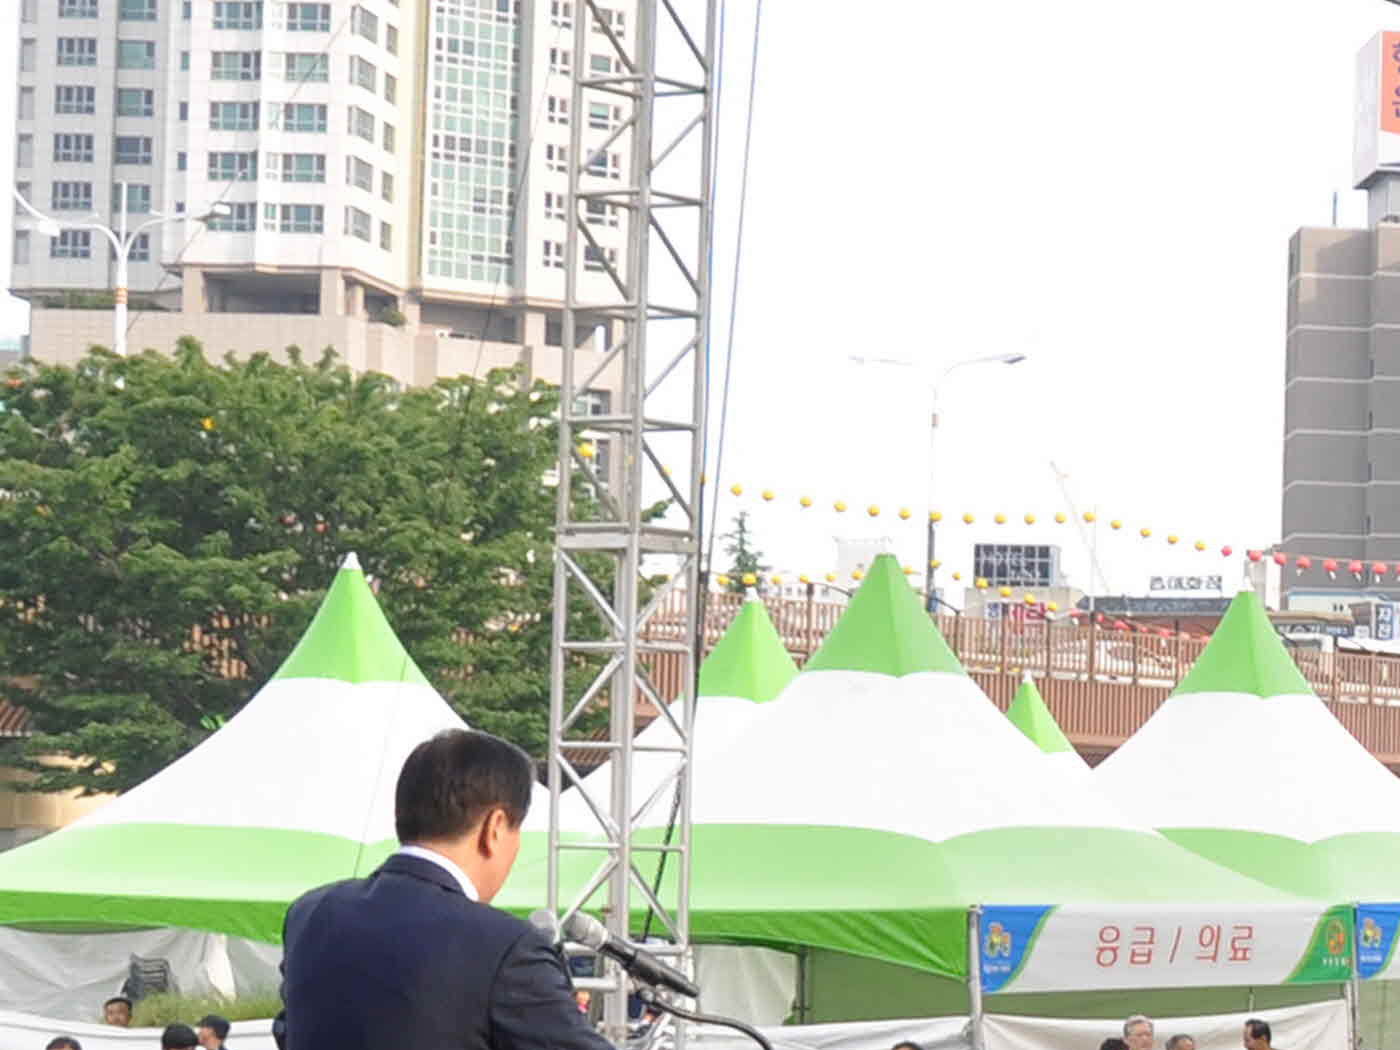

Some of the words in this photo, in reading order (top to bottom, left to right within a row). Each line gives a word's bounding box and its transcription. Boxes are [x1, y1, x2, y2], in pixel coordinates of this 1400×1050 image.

[1096, 925, 1155, 968] 응급
[1168, 926, 1183, 964] /
[1195, 923, 1255, 963] 의료
